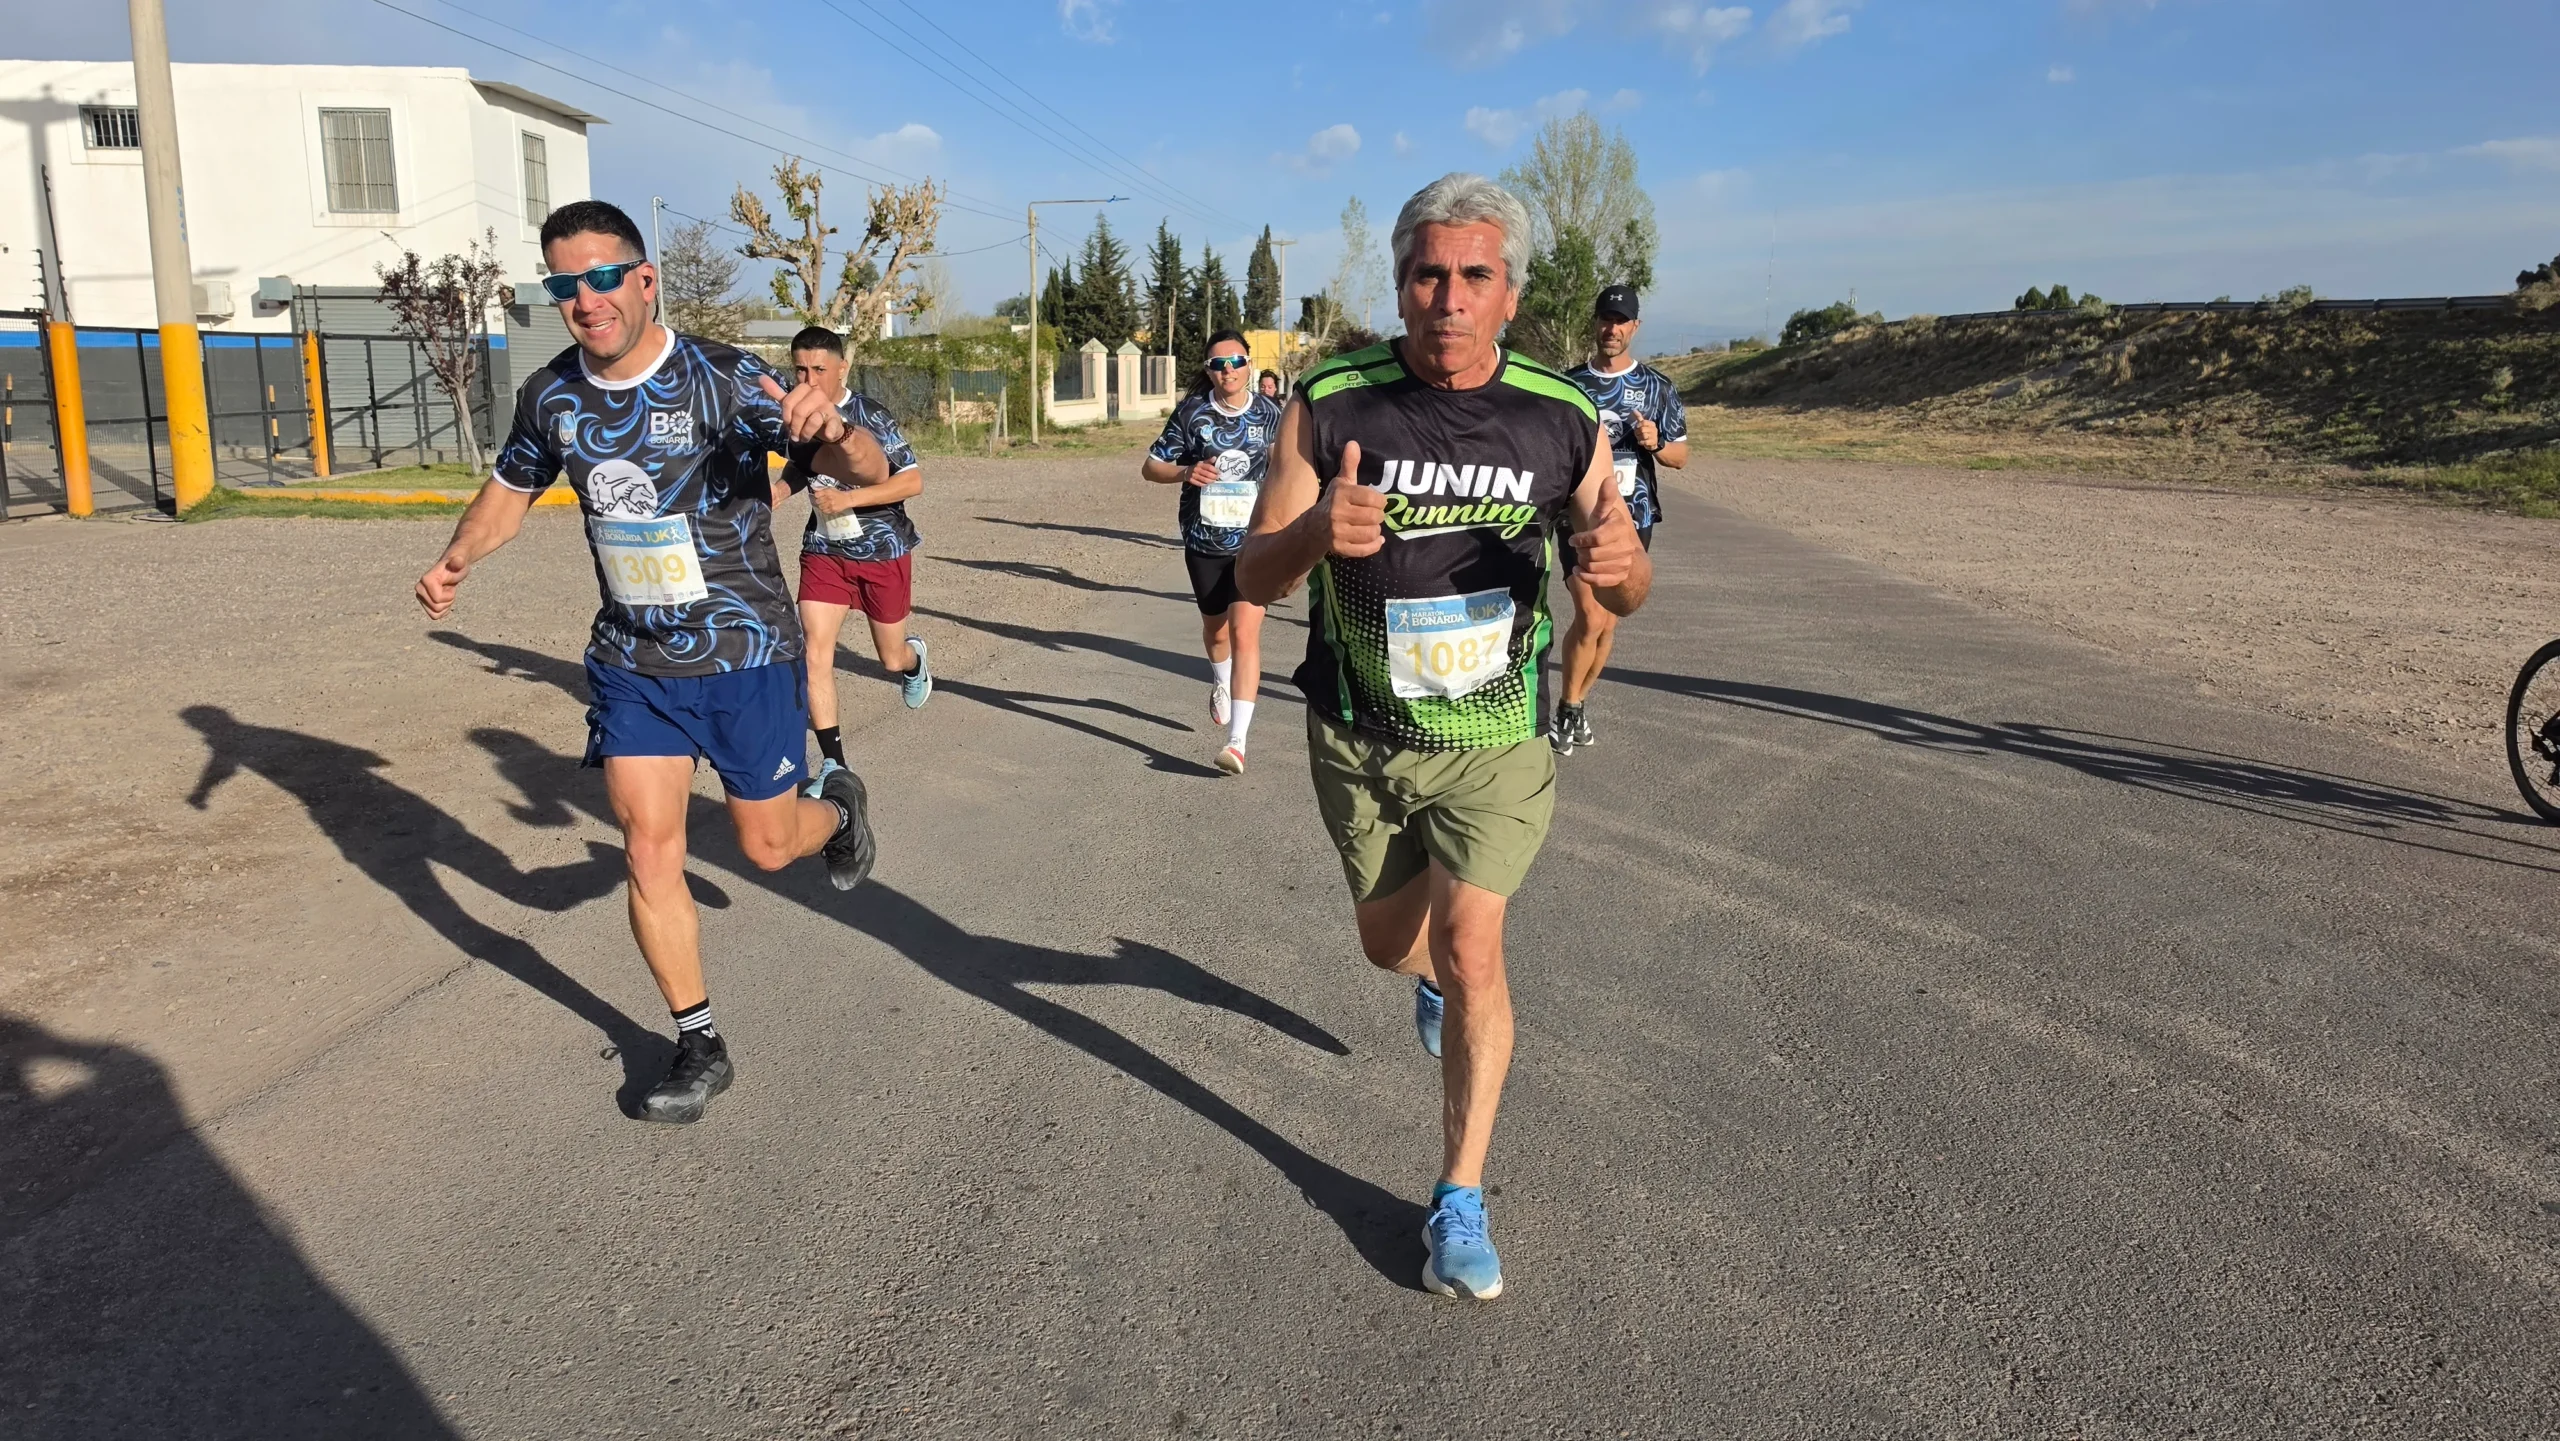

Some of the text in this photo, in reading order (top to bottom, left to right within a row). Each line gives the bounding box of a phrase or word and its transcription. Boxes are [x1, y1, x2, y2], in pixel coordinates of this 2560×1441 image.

[650, 435, 694, 445] BONARDA
[1367, 459, 1535, 504] JUNIN
[1382, 493, 1538, 540] Running
[604, 528, 672, 544] BONARDA 10K
[607, 553, 687, 585] 1309
[1411, 602, 1498, 620] MARATÓN 10K
[1411, 613, 1466, 627] BONARDA
[1405, 630, 1501, 677] 1087
[772, 764, 796, 781] adidas
